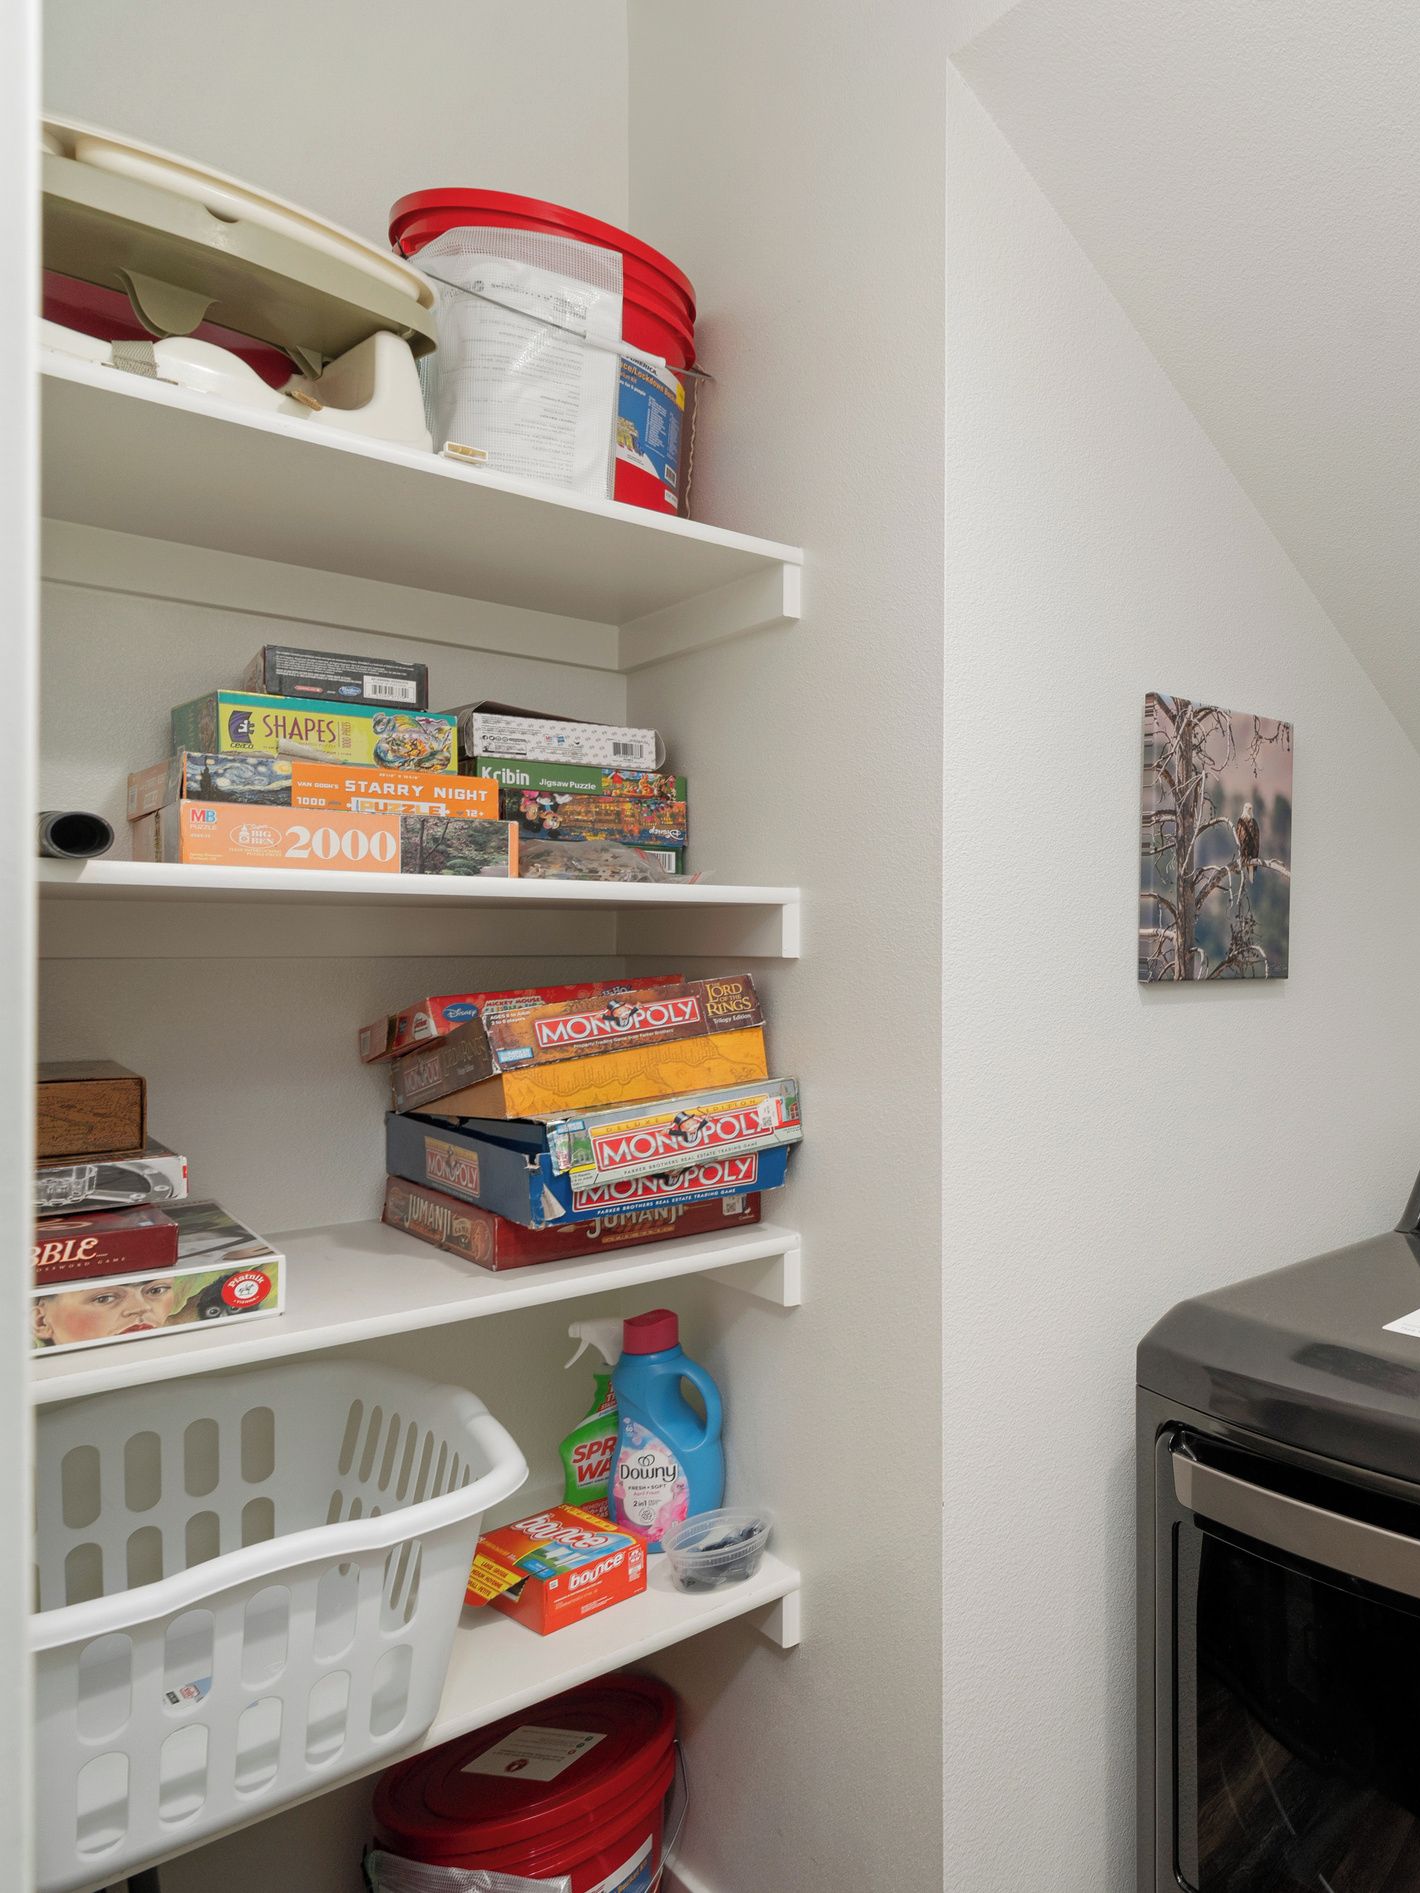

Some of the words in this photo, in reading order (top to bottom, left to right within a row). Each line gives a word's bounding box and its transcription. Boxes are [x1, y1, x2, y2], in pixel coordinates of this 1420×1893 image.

[262, 713, 337, 744] SHAPES
[297, 781, 312, 789] VAN
[344, 779, 424, 798] STARRY
[433, 785, 489, 802] NIGHT
[481, 766, 530, 787] Kribin
[538, 778, 569, 791] Jigsaw
[569, 780, 597, 791] Puzzle
[296, 796, 326, 807] 1000
[465, 808, 485, 818] 12+
[190, 808, 217, 824] MB
[284, 825, 397, 863] 2000
[705, 983, 742, 1003] LORD
[447, 1005, 478, 1018] Disney
[705, 996, 752, 1017] RINGS
[732, 1013, 752, 1021] Edition
[541, 1000, 693, 1044] MONOPOLY
[605, 1117, 661, 1133] DELUXE
[623, 1166, 646, 1175] PARKER
[648, 1159, 679, 1171] BROTHERS
[680, 1155, 695, 1163] REAL
[743, 1141, 758, 1150] GAME
[596, 1206, 621, 1215] PARKER
[622, 1201, 654, 1212] BROTHERS
[671, 1195, 692, 1203] ESTATE
[693, 1190, 719, 1200] TRADING
[719, 1187, 736, 1196] GAME
[403, 1193, 452, 1243] JUMANJI
[586, 1203, 684, 1239] JUMANJI
[31, 1237, 99, 1267] BBLE
[227, 1273, 265, 1288] Piatnik
[572, 1435, 618, 1465] SPR
[577, 1458, 611, 1483] WA
[619, 1462, 677, 1483] Downy
[513, 1514, 609, 1550] bounce
[567, 1551, 624, 1591] bounce
